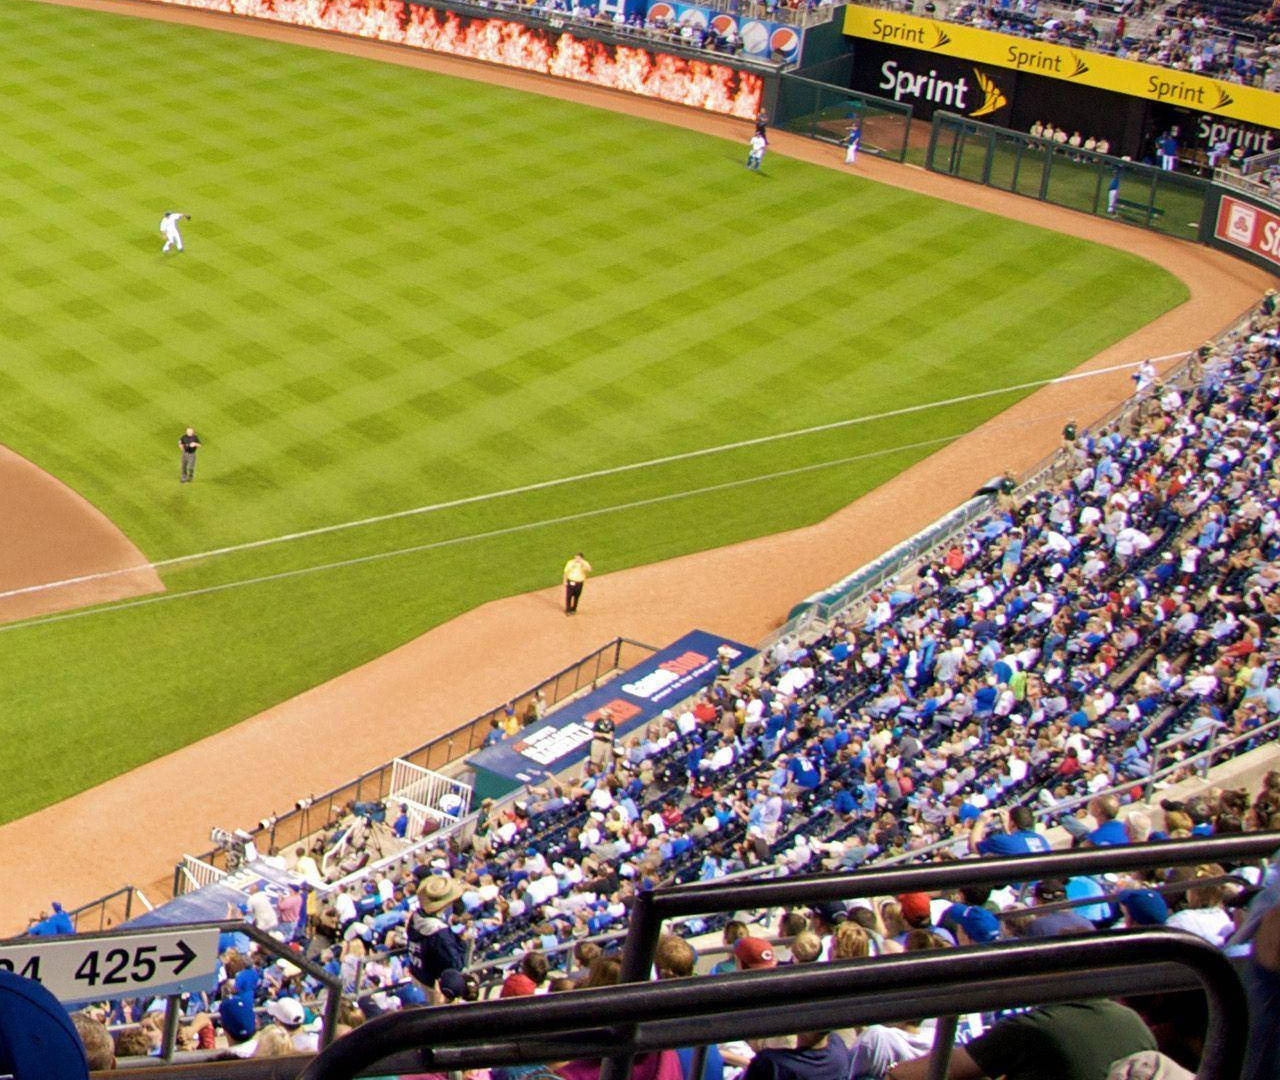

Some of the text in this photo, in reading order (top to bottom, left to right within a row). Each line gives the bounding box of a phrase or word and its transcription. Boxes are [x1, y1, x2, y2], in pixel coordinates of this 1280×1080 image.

[872, 18, 926, 45] Sprint
[1007, 45, 1062, 73] Sprint
[879, 59, 970, 110] Sprint
[1146, 75, 1205, 105] Sprint
[1198, 115, 1275, 153] Sprint
[74, 943, 159, 987] 425
